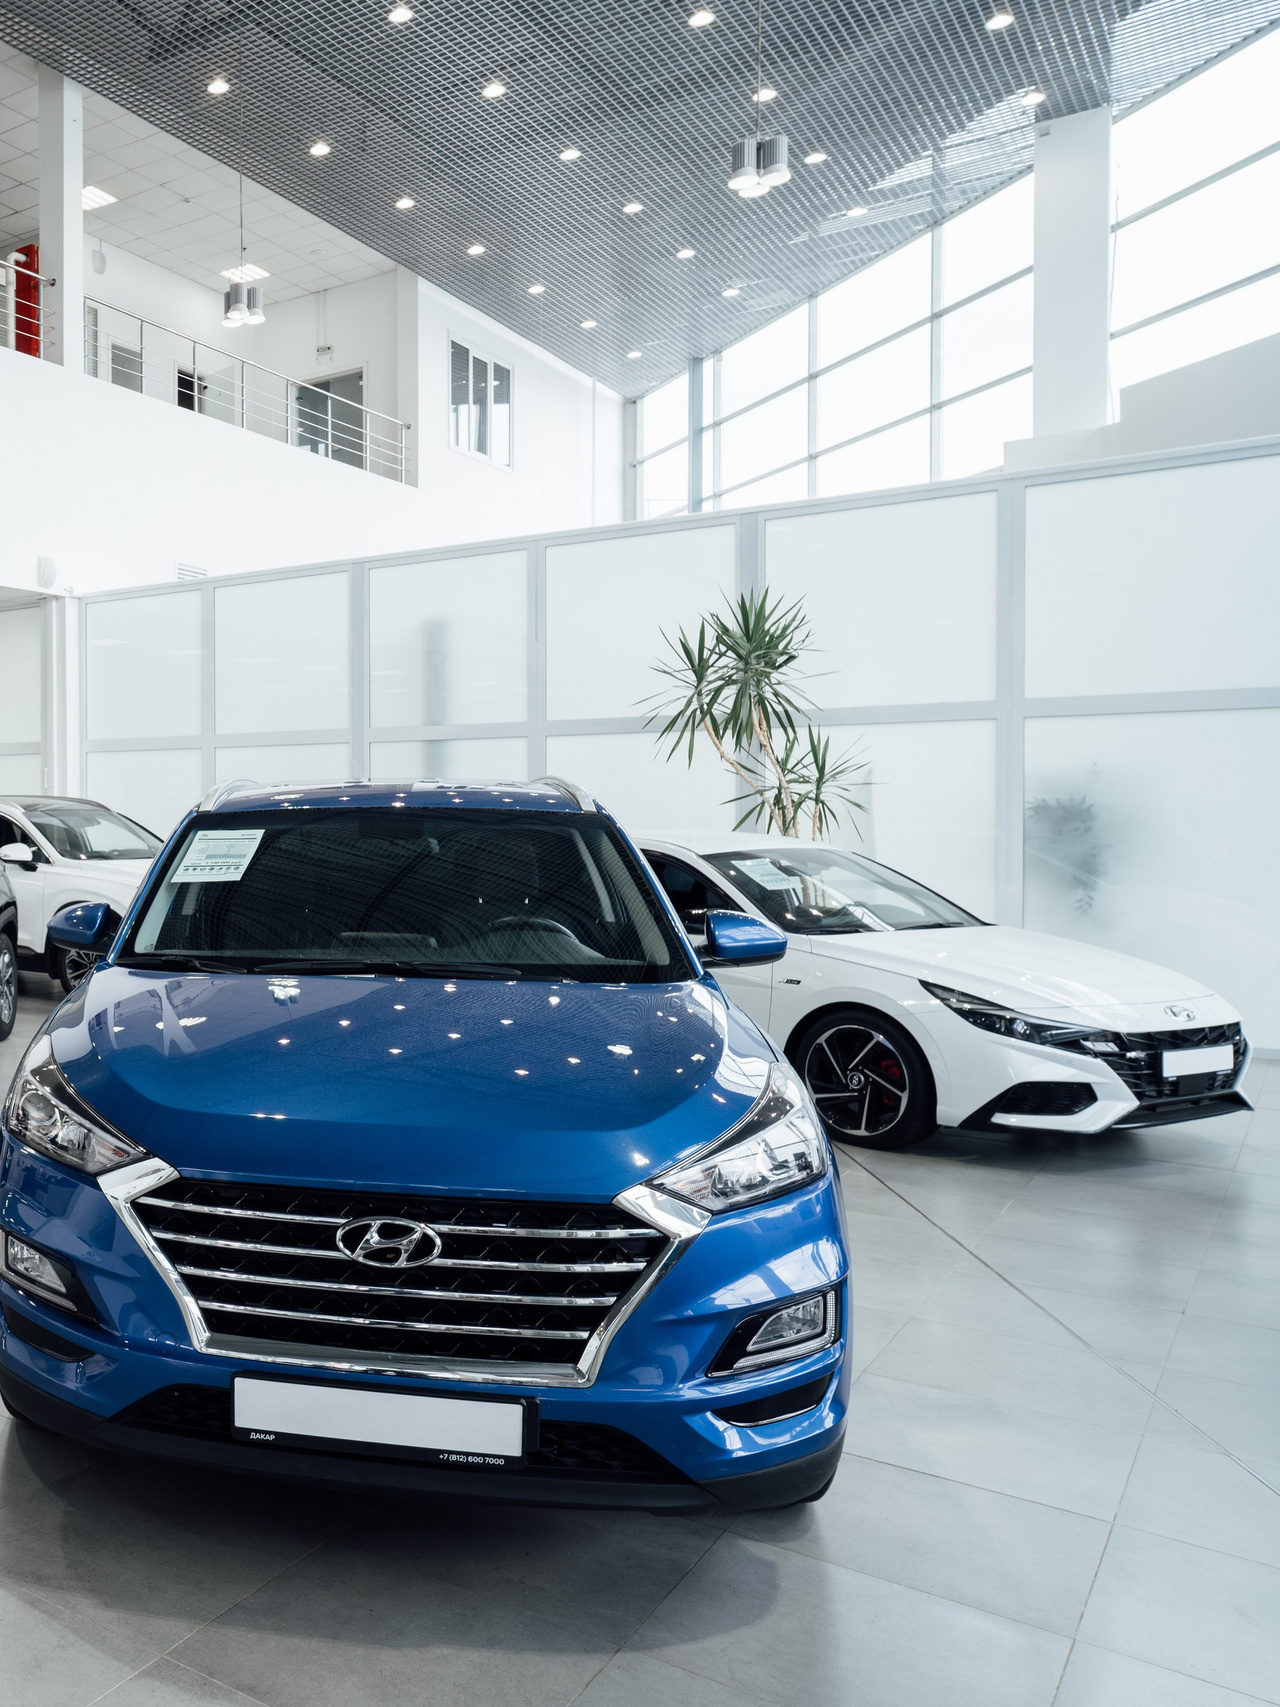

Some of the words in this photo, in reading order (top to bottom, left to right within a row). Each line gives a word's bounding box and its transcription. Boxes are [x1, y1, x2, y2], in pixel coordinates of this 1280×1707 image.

[250, 1432, 275, 1441] ДАКАР
[449, 1454, 467, 1463] (812)
[468, 1455, 483, 1463] 600
[484, 1457, 505, 1465] 7000
